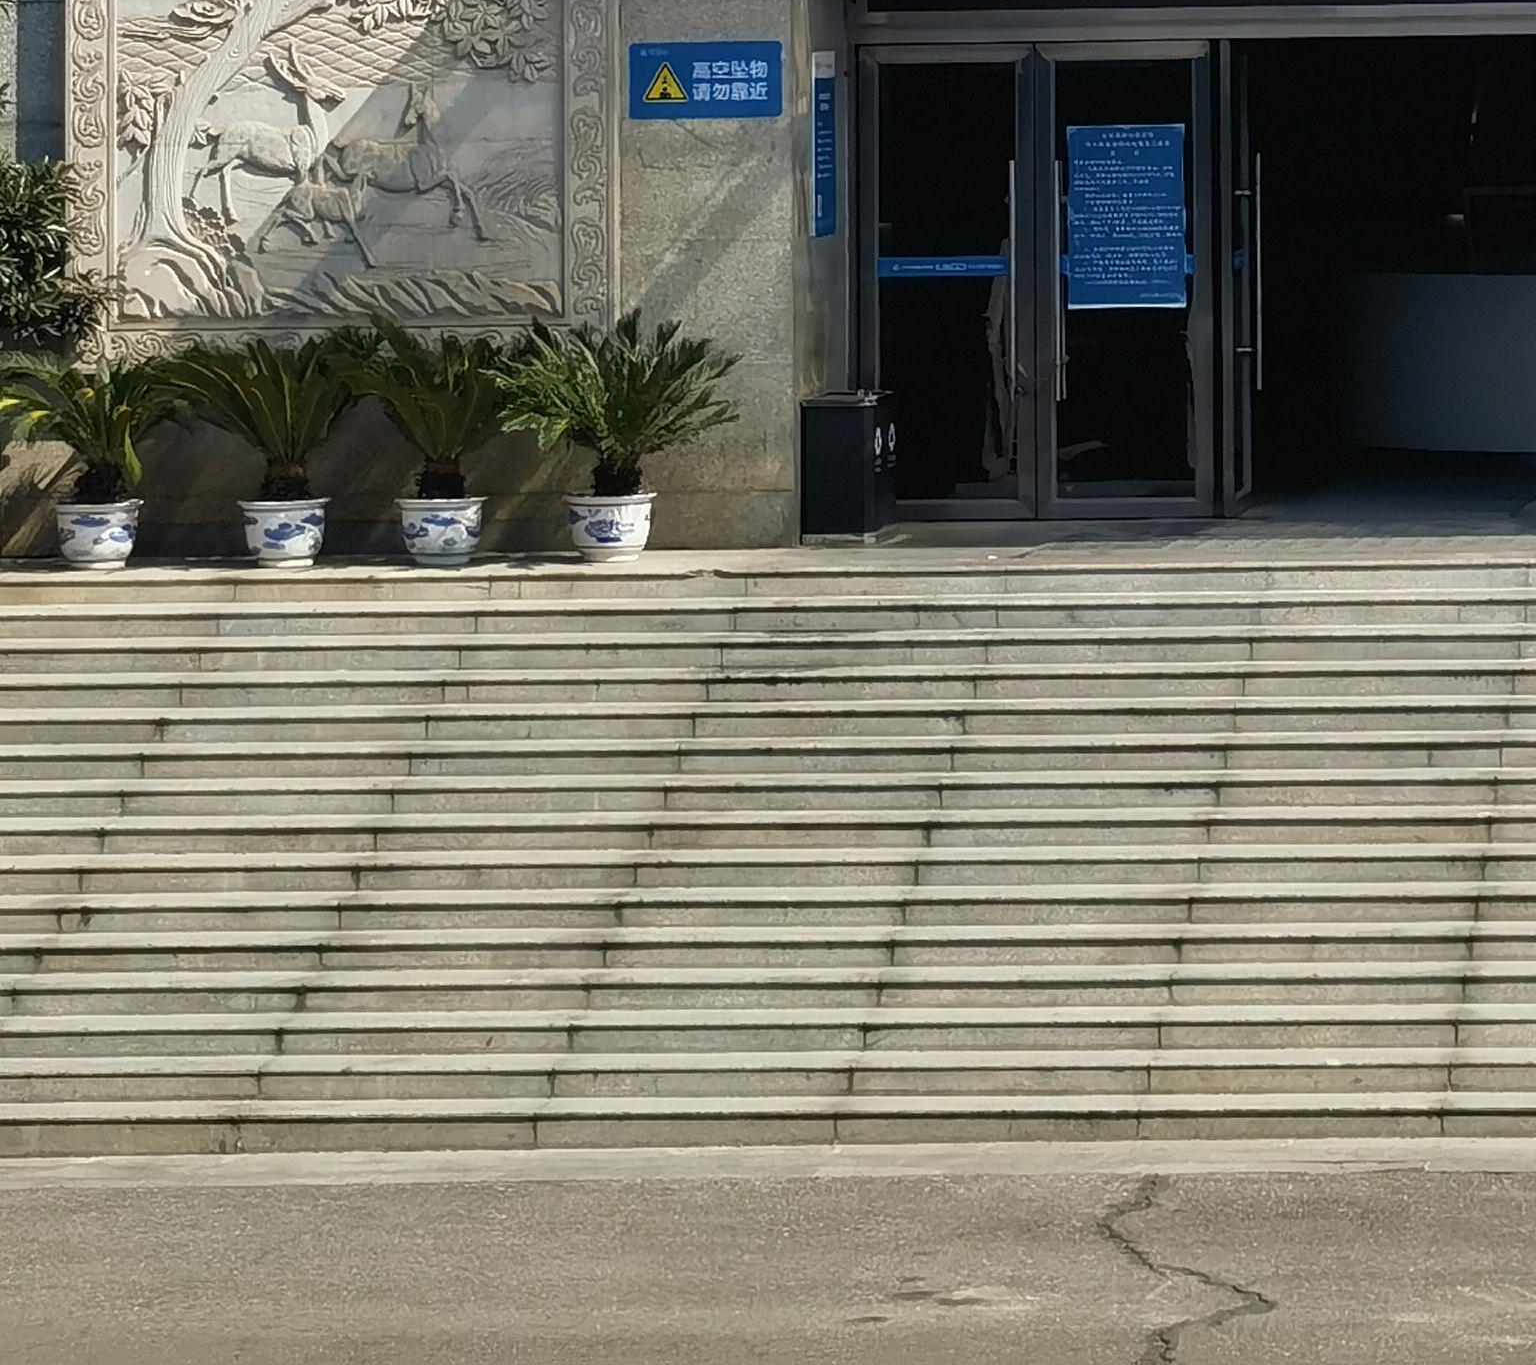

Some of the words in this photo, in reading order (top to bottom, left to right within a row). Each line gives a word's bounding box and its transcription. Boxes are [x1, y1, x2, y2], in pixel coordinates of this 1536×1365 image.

[692, 60, 768, 79] 高空坠物
[692, 81, 768, 101] 请勿靠近
